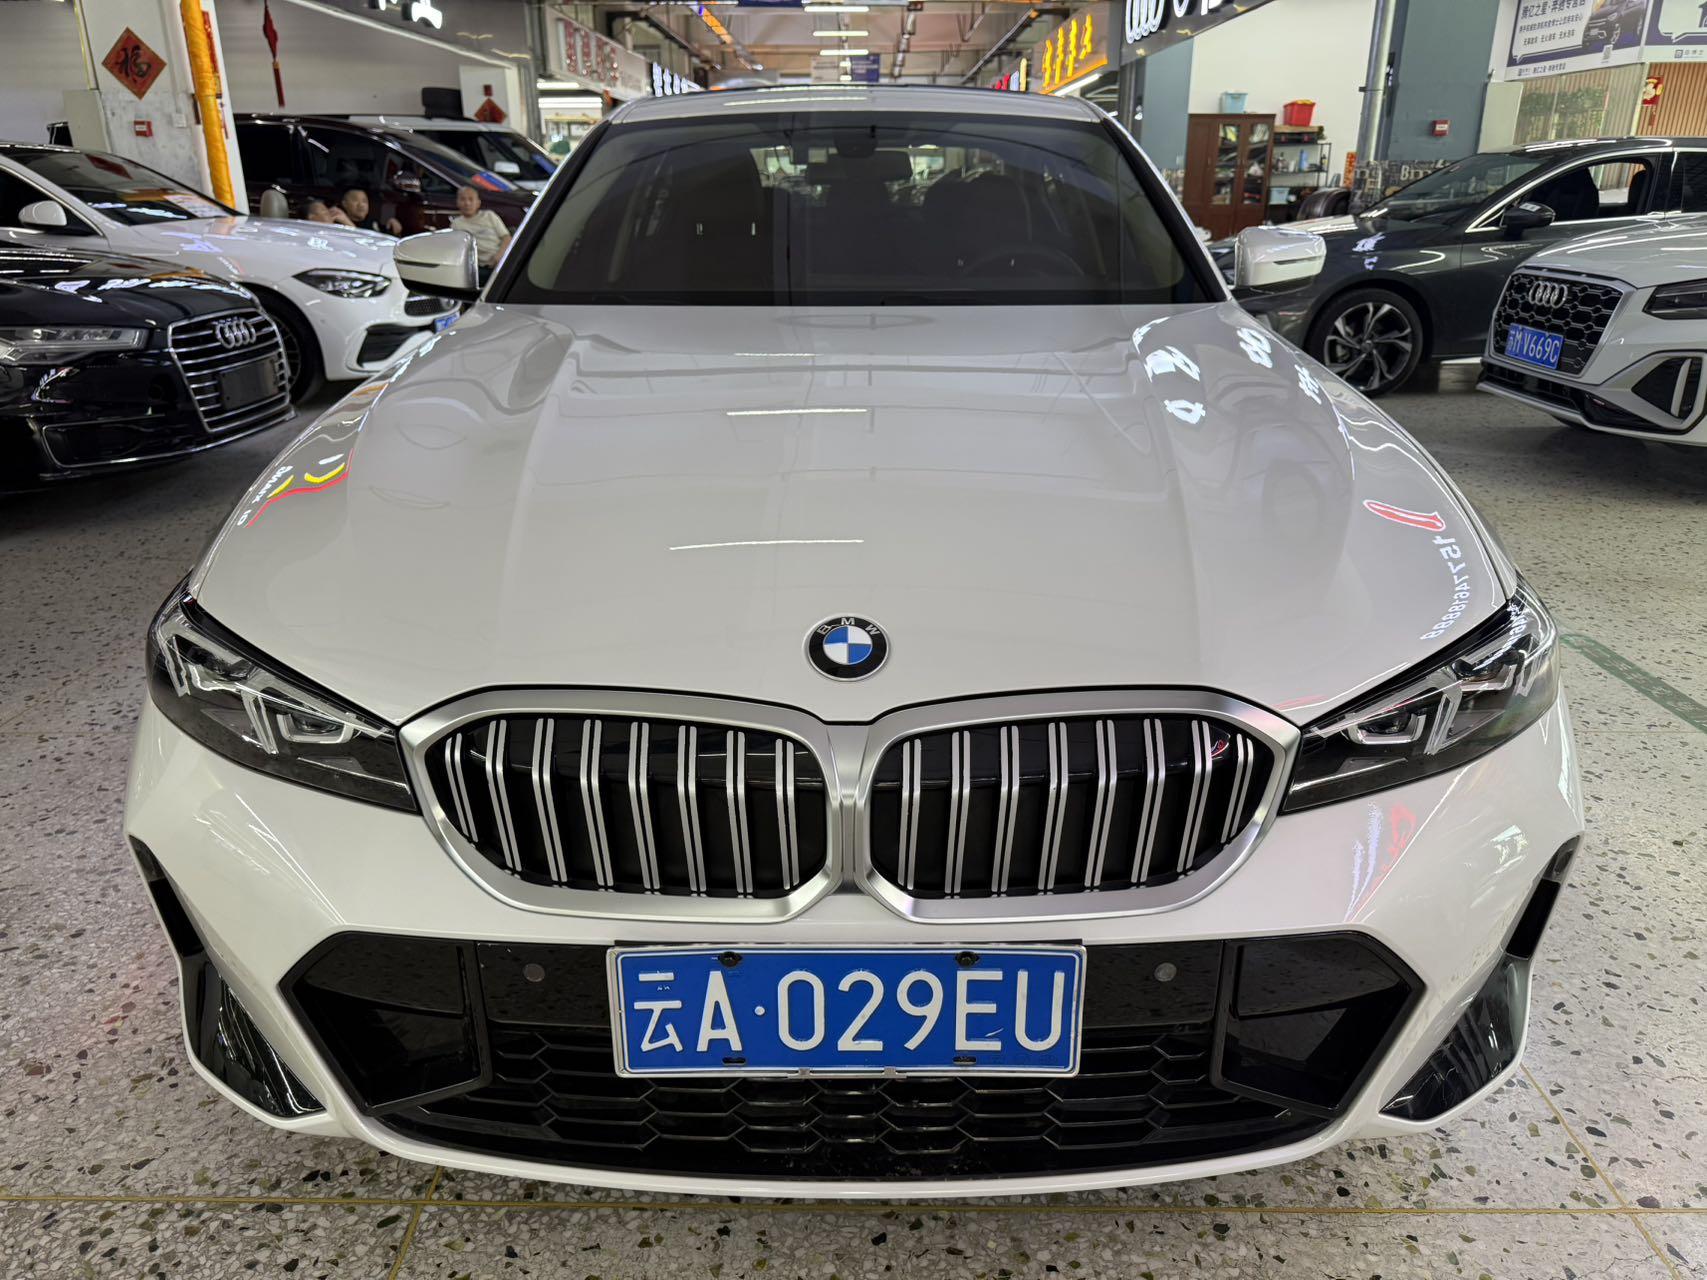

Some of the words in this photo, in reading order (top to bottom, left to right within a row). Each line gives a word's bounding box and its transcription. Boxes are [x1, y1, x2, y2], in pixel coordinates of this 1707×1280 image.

[116, 45, 152, 83] 福
[816, 617, 881, 636] BMW
[633, 970, 1066, 1052] 云A·029EU
